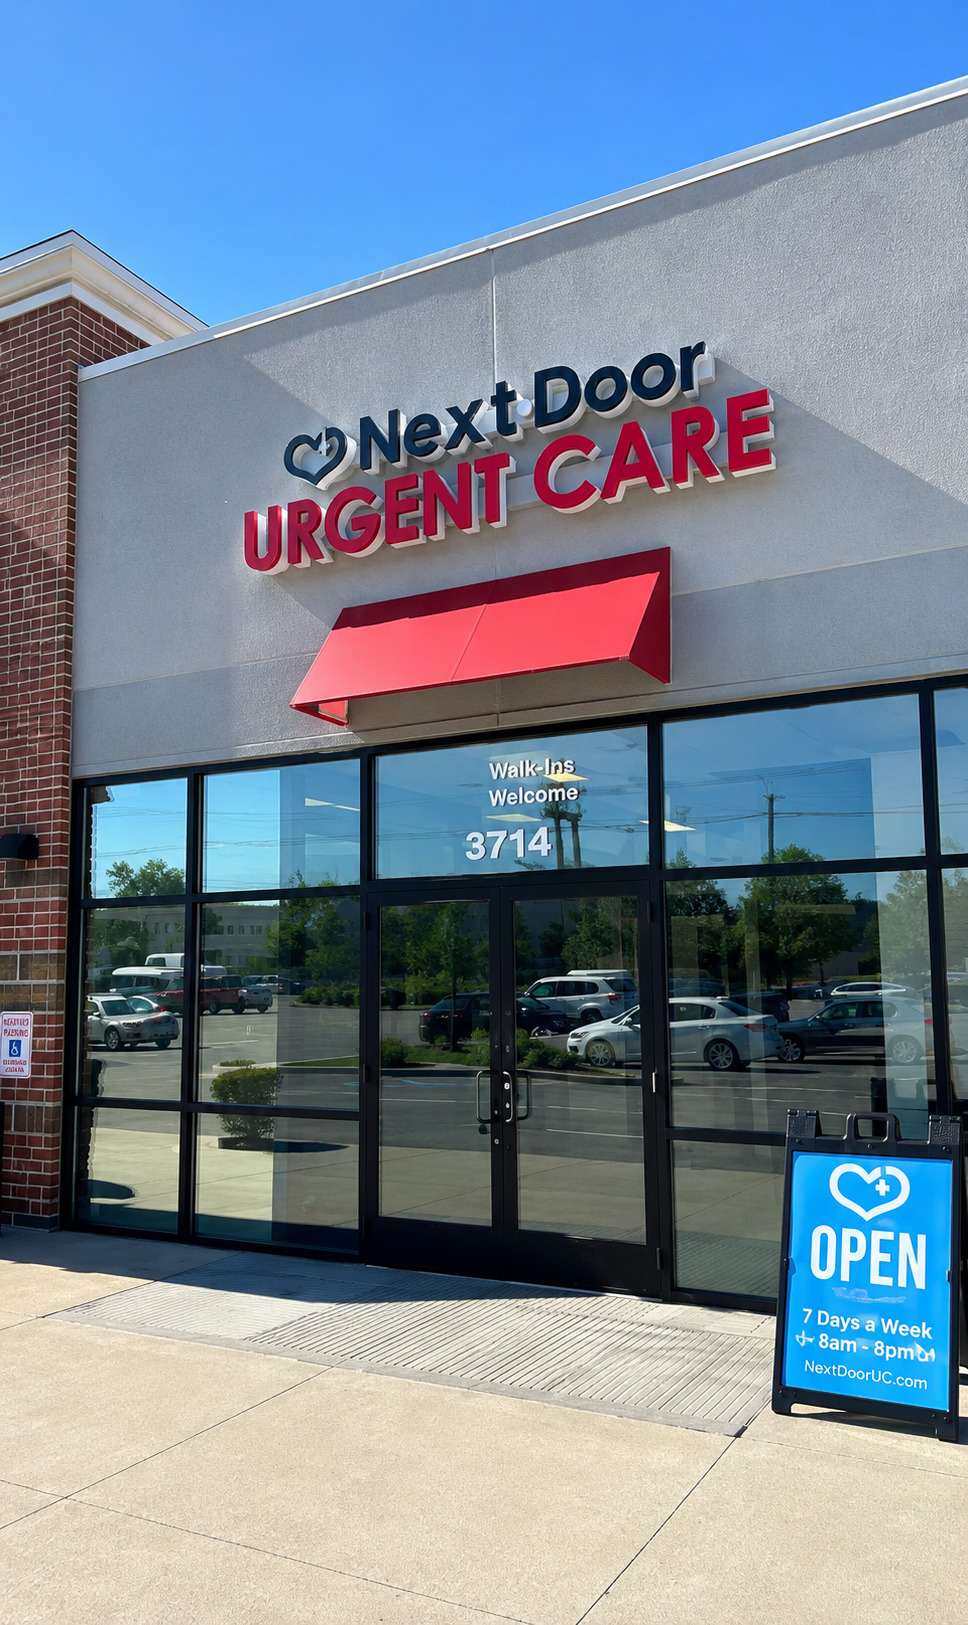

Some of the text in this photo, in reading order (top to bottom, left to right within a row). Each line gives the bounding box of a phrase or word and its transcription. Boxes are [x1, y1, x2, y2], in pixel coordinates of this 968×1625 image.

[359, 340, 708, 471] Next Door
[244, 388, 774, 572] URGENT CARE
[488, 757, 576, 780] Walk-Ins
[488, 786, 579, 807] Welcome
[465, 826, 552, 861] 3714
[810, 1225, 927, 1290] OPEN
[802, 1308, 933, 1339] 7 Days a Week
[818, 1333, 857, 1352] 8am
[874, 1340, 914, 1361] 8pm
[804, 1360, 928, 1390] NextDoorUC.com
